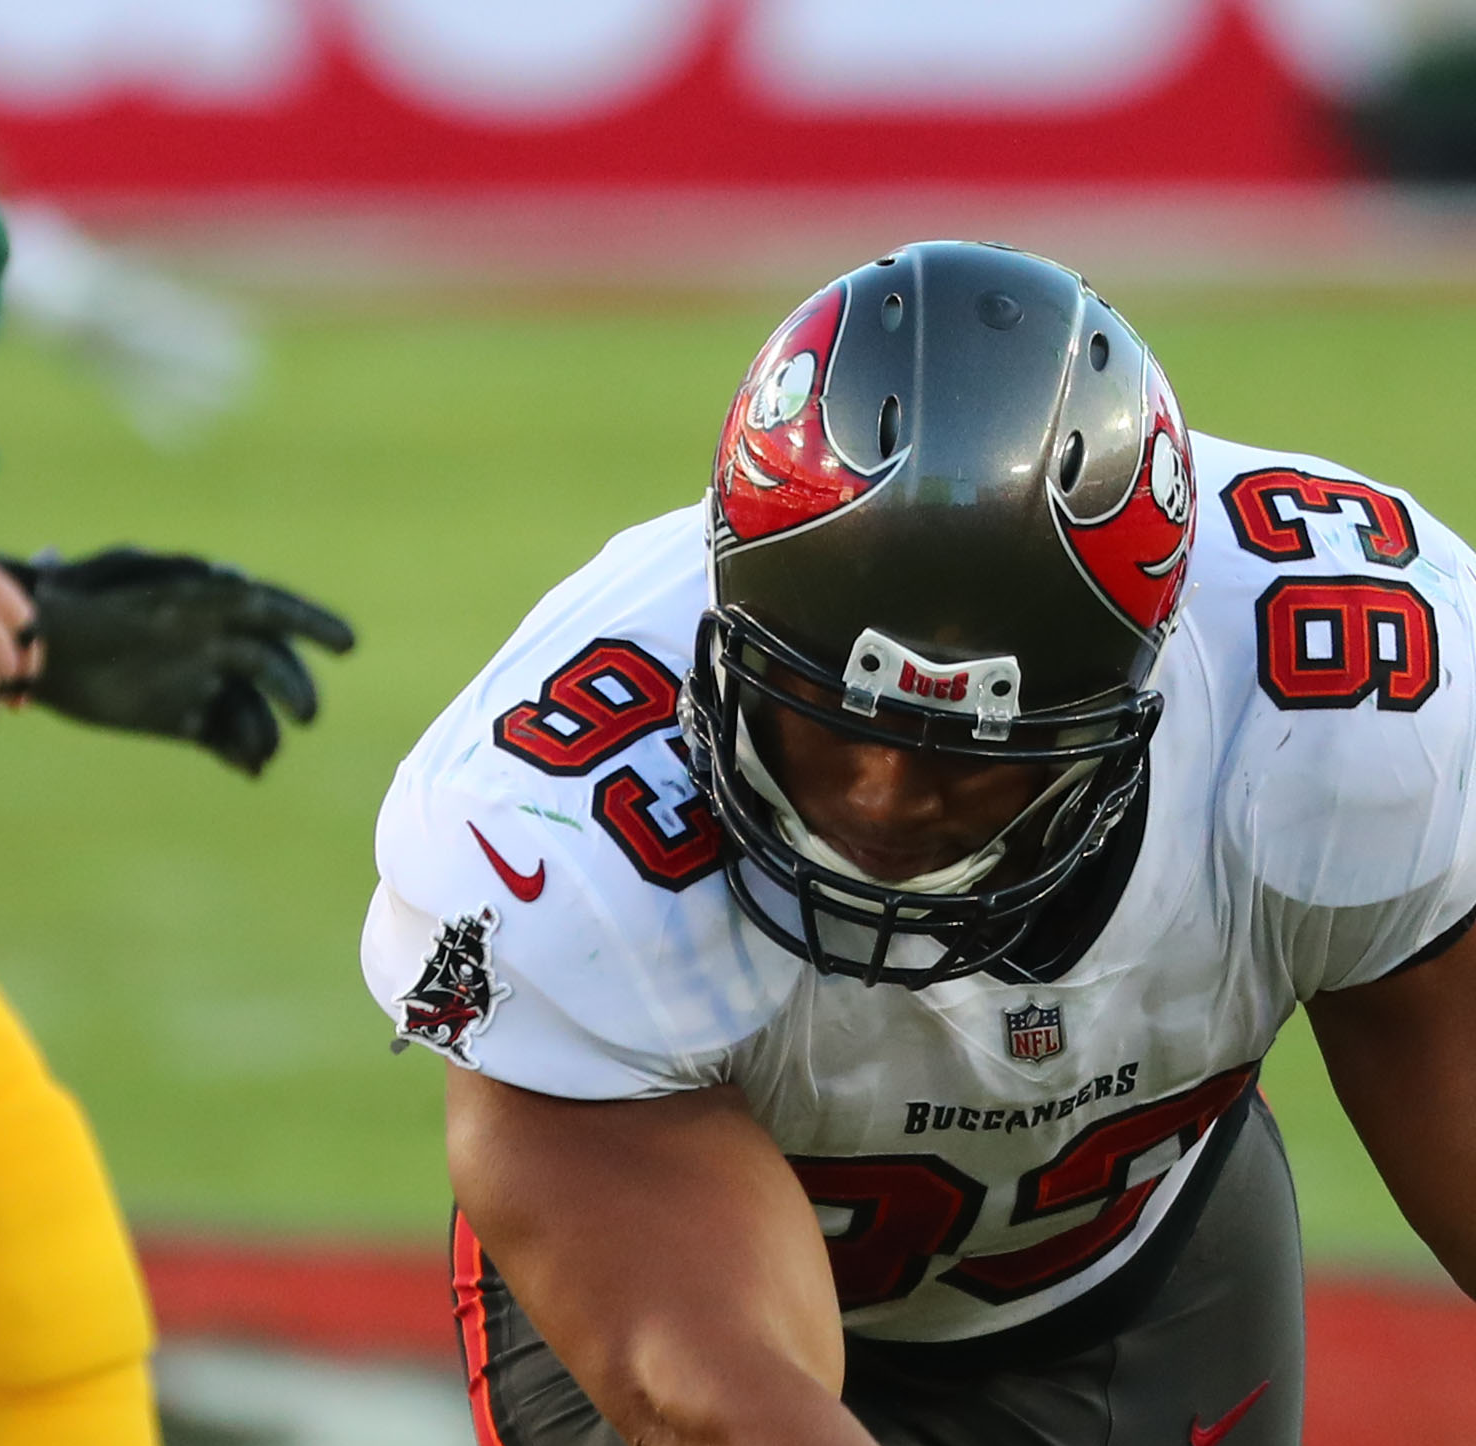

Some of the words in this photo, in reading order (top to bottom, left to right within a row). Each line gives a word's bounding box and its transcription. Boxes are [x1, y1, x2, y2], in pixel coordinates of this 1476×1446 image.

[1218, 466, 1440, 713] 93
[493, 637, 728, 894] 93
[904, 1062, 1140, 1136] BUCCANEERS
[1013, 1027, 1060, 1058] NFL
